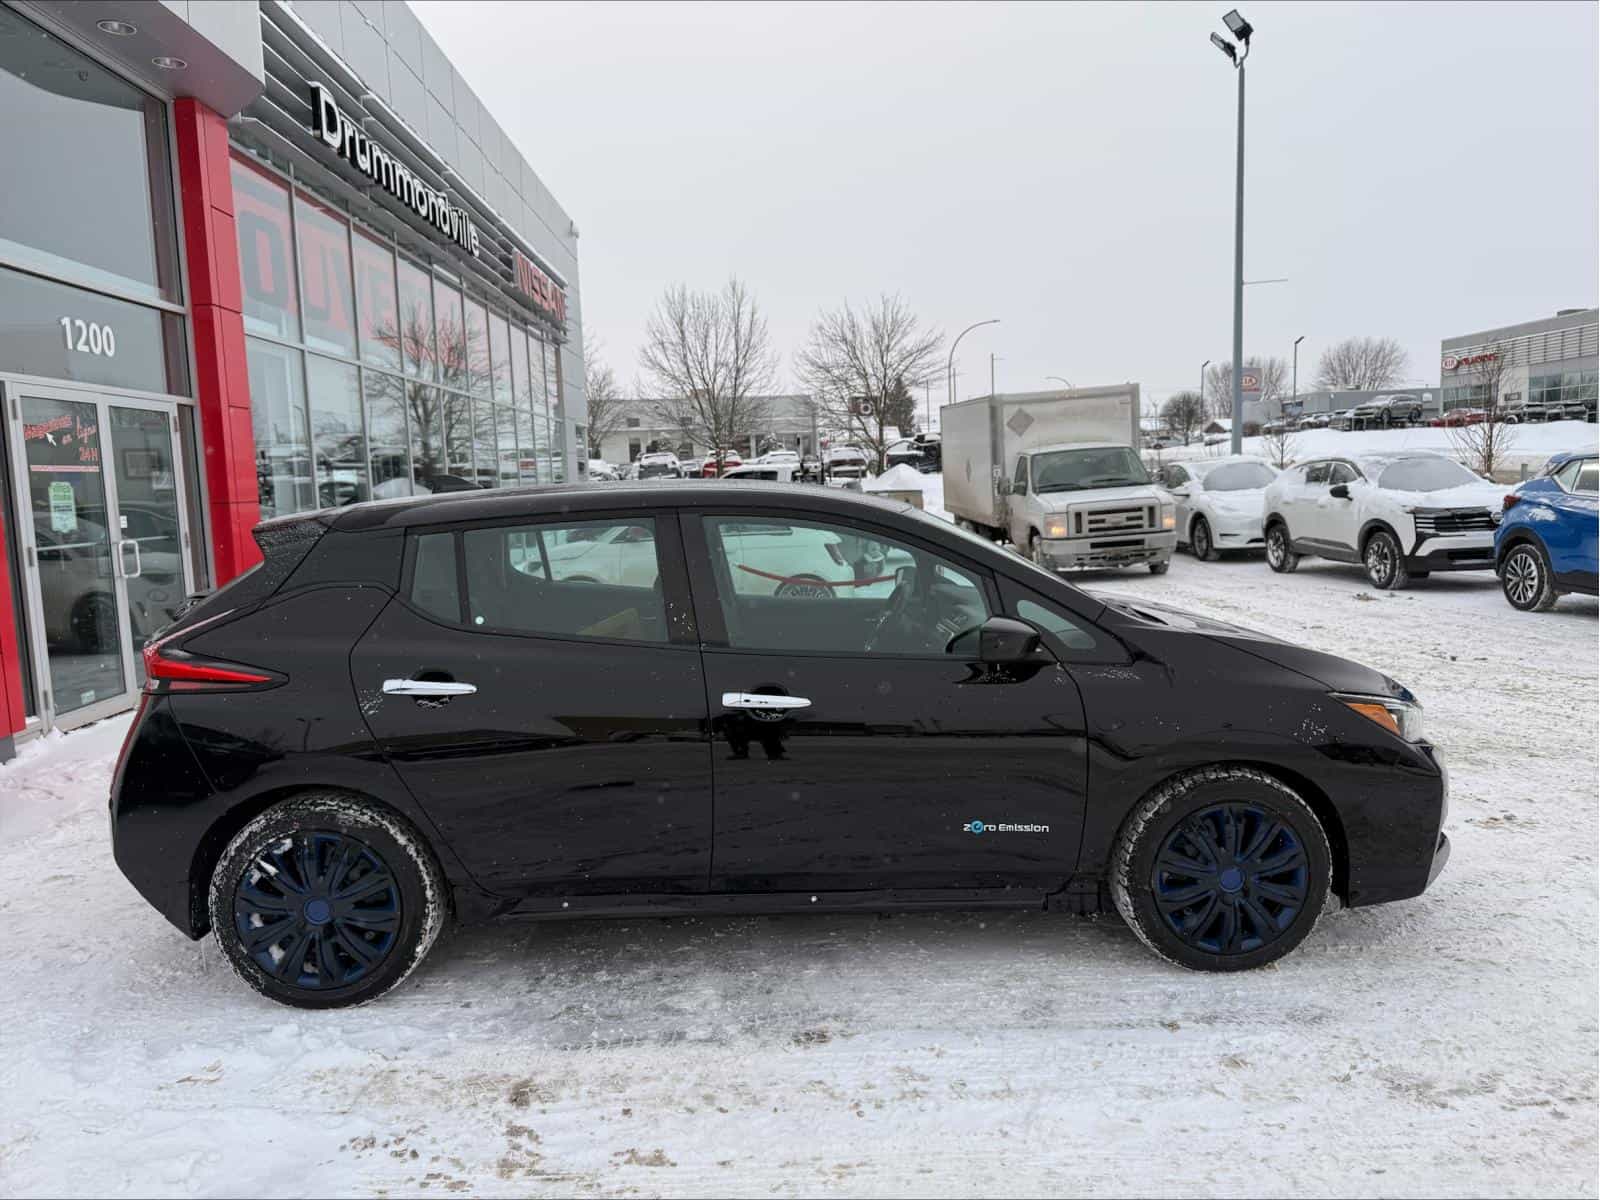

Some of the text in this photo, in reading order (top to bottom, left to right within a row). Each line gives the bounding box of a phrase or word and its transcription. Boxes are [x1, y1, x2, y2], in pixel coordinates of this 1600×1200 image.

[312, 82, 480, 257] Drummondville
[515, 251, 566, 321] NISSAN
[60, 316, 116, 357] 1200
[999, 823, 1049, 832] Emission
